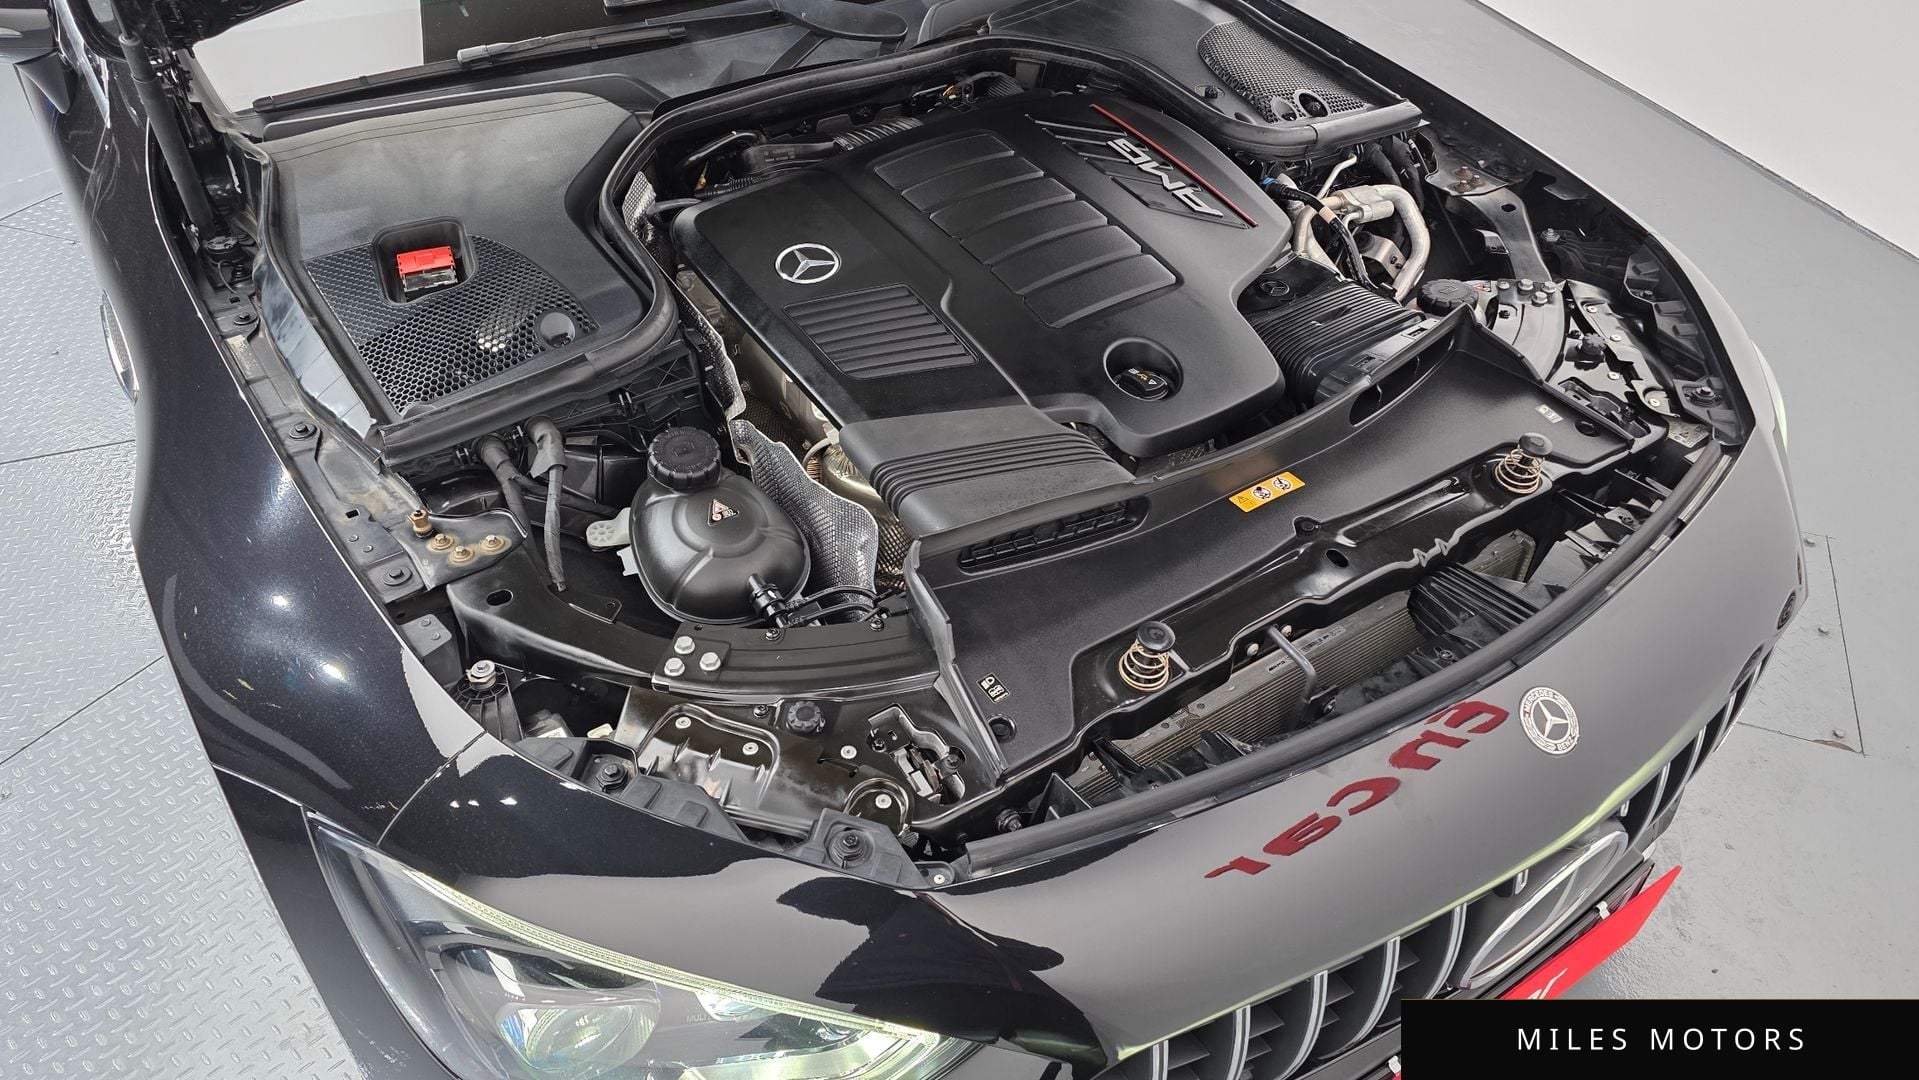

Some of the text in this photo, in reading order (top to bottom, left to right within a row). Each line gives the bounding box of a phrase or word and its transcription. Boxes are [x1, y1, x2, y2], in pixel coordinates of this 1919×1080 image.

[1107, 138, 1224, 218] AMG
[1523, 689, 1555, 713] MERCEDES
[1557, 736, 1575, 751] BENZ
